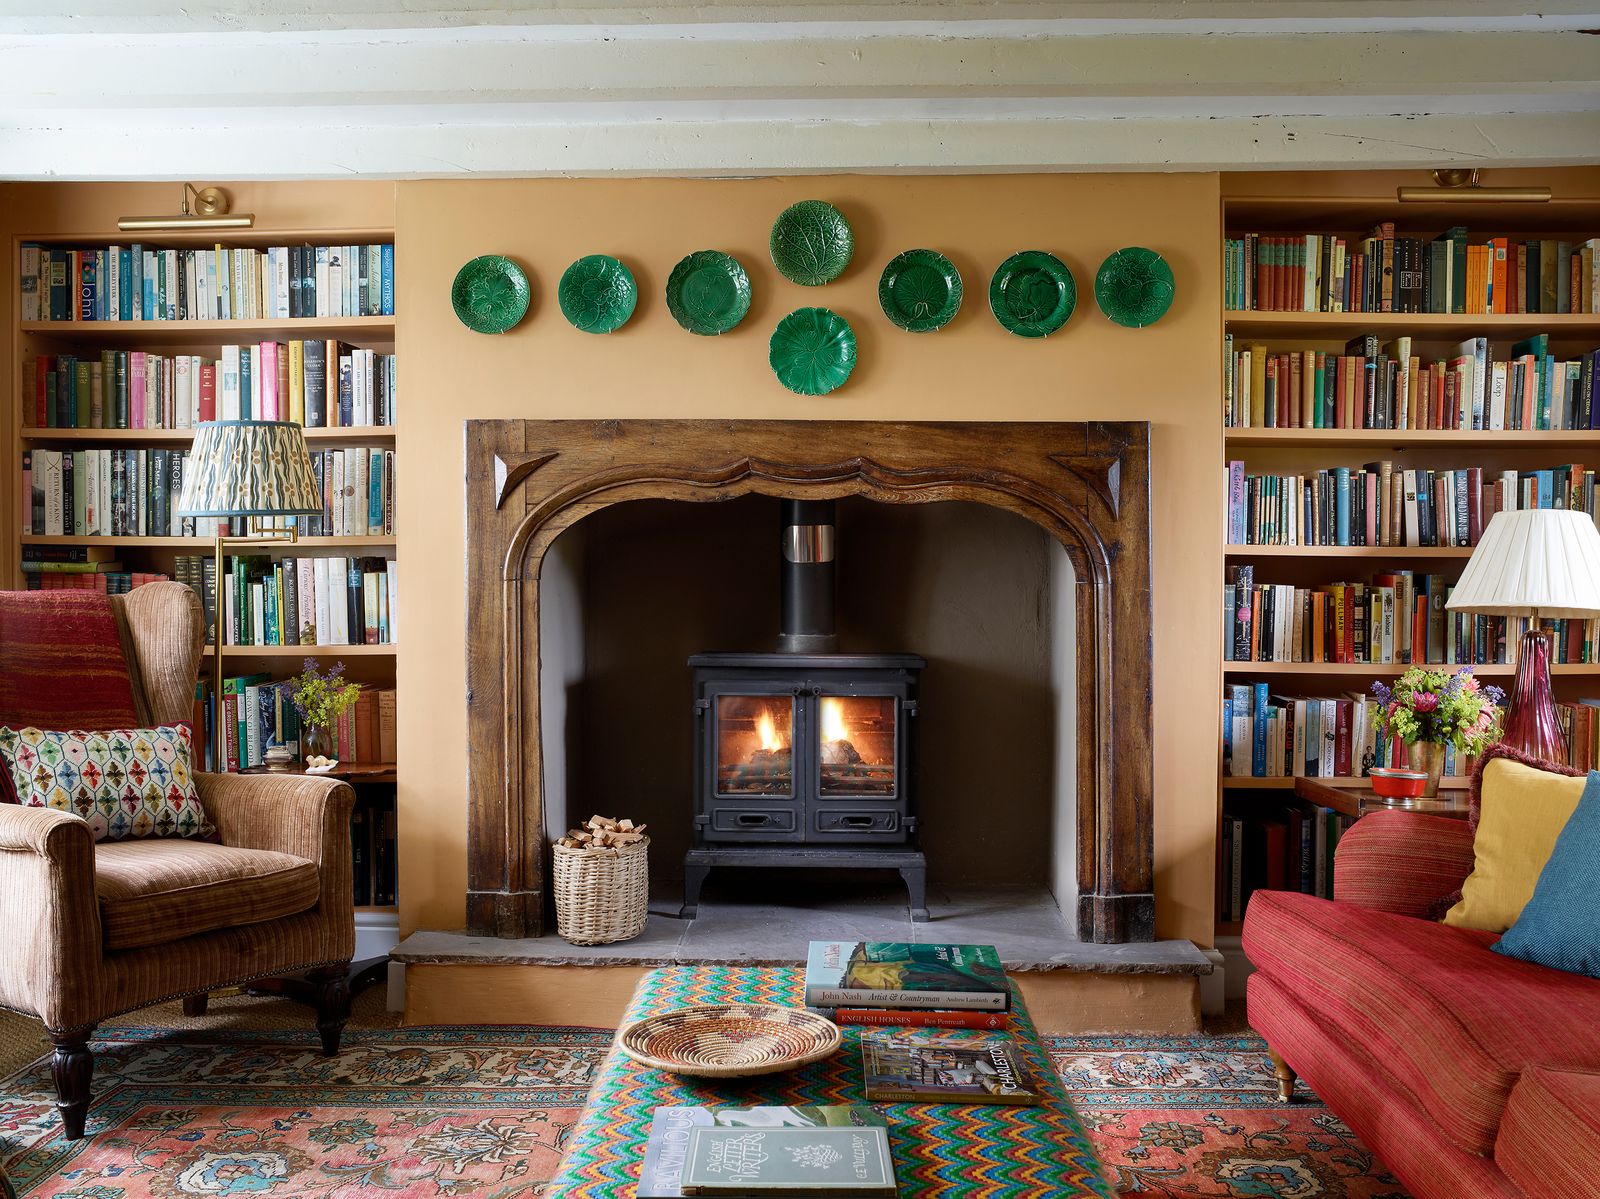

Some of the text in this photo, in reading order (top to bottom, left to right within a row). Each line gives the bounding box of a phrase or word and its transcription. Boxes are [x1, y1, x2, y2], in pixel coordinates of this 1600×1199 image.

[82, 281, 96, 318] John
[1493, 376, 1505, 398] Loop
[172, 453, 181, 490] HEROES
[247, 721, 254, 733] OF
[1286, 702, 1294, 750] CIRCE
[820, 991, 840, 1001] John
[842, 992, 862, 1000] Nash
[868, 993, 888, 1001] Artist
[889, 993, 898, 1001] &
[899, 993, 941, 1004] Countryman
[989, 1041, 1018, 1090] CHARLESTON
[874, 1092, 916, 1100] CHARLESTON
[652, 1109, 695, 1191] RAVILIOUS
[707, 1139, 724, 1173] ENGLISH
[729, 1132, 769, 1182] WRITERS
